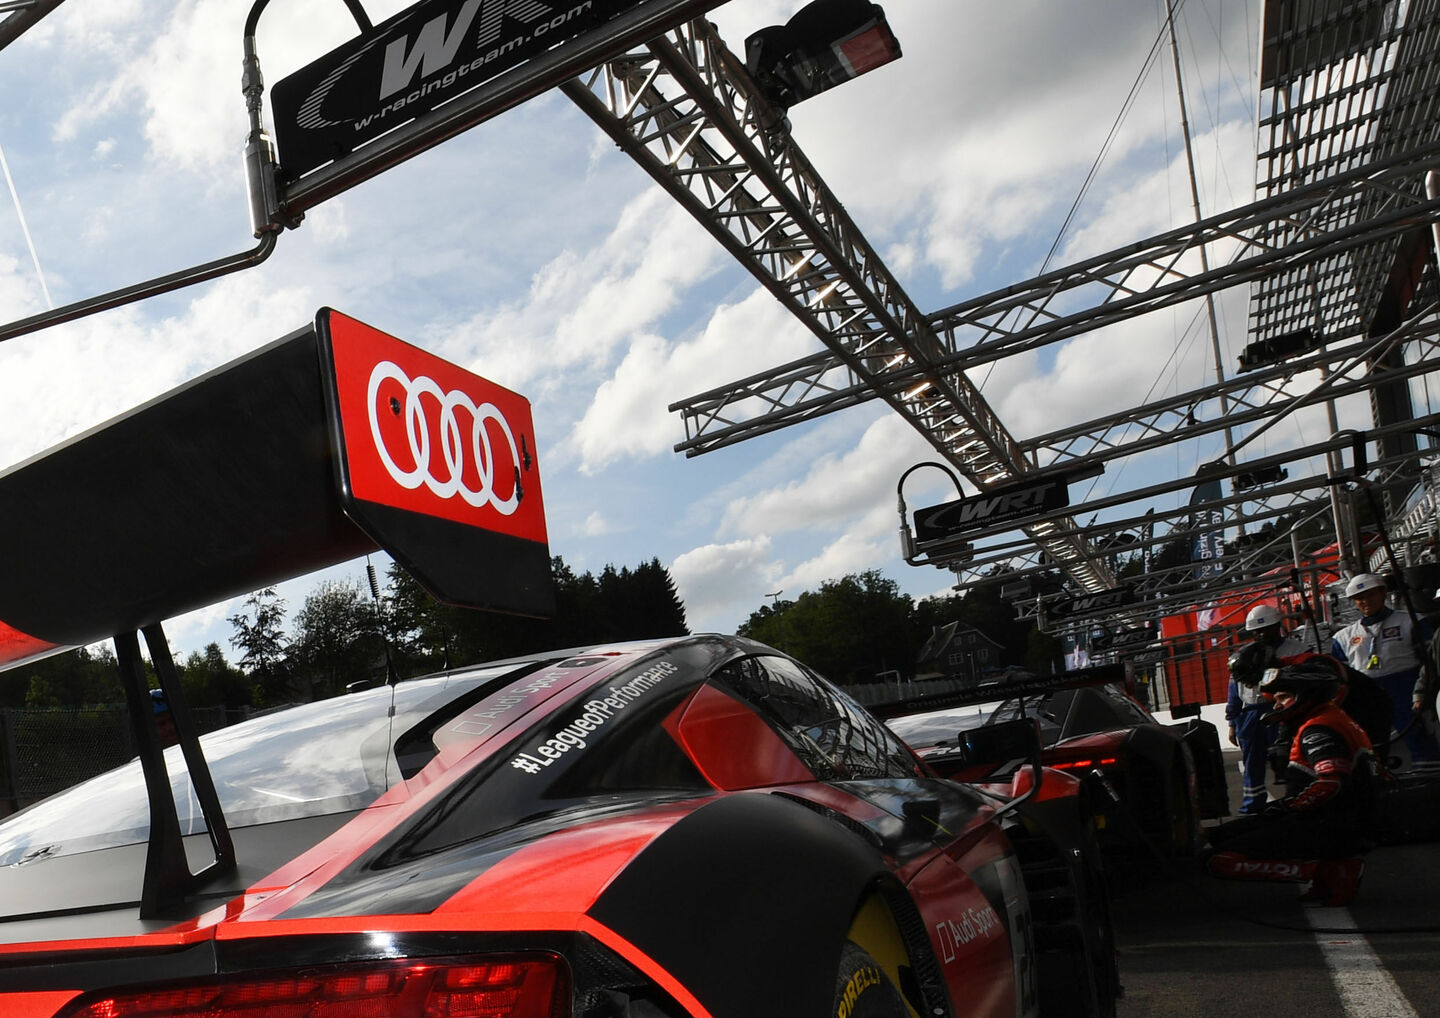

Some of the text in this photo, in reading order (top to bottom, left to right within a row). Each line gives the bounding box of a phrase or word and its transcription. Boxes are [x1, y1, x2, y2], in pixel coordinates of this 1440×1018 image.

[354, 0, 593, 131] w-racingteam.com
[960, 482, 1057, 523] WRT
[474, 671, 570, 719] Audi Sport
[510, 660, 679, 774] #LeagueofPerformance
[948, 911, 978, 949] Audi
